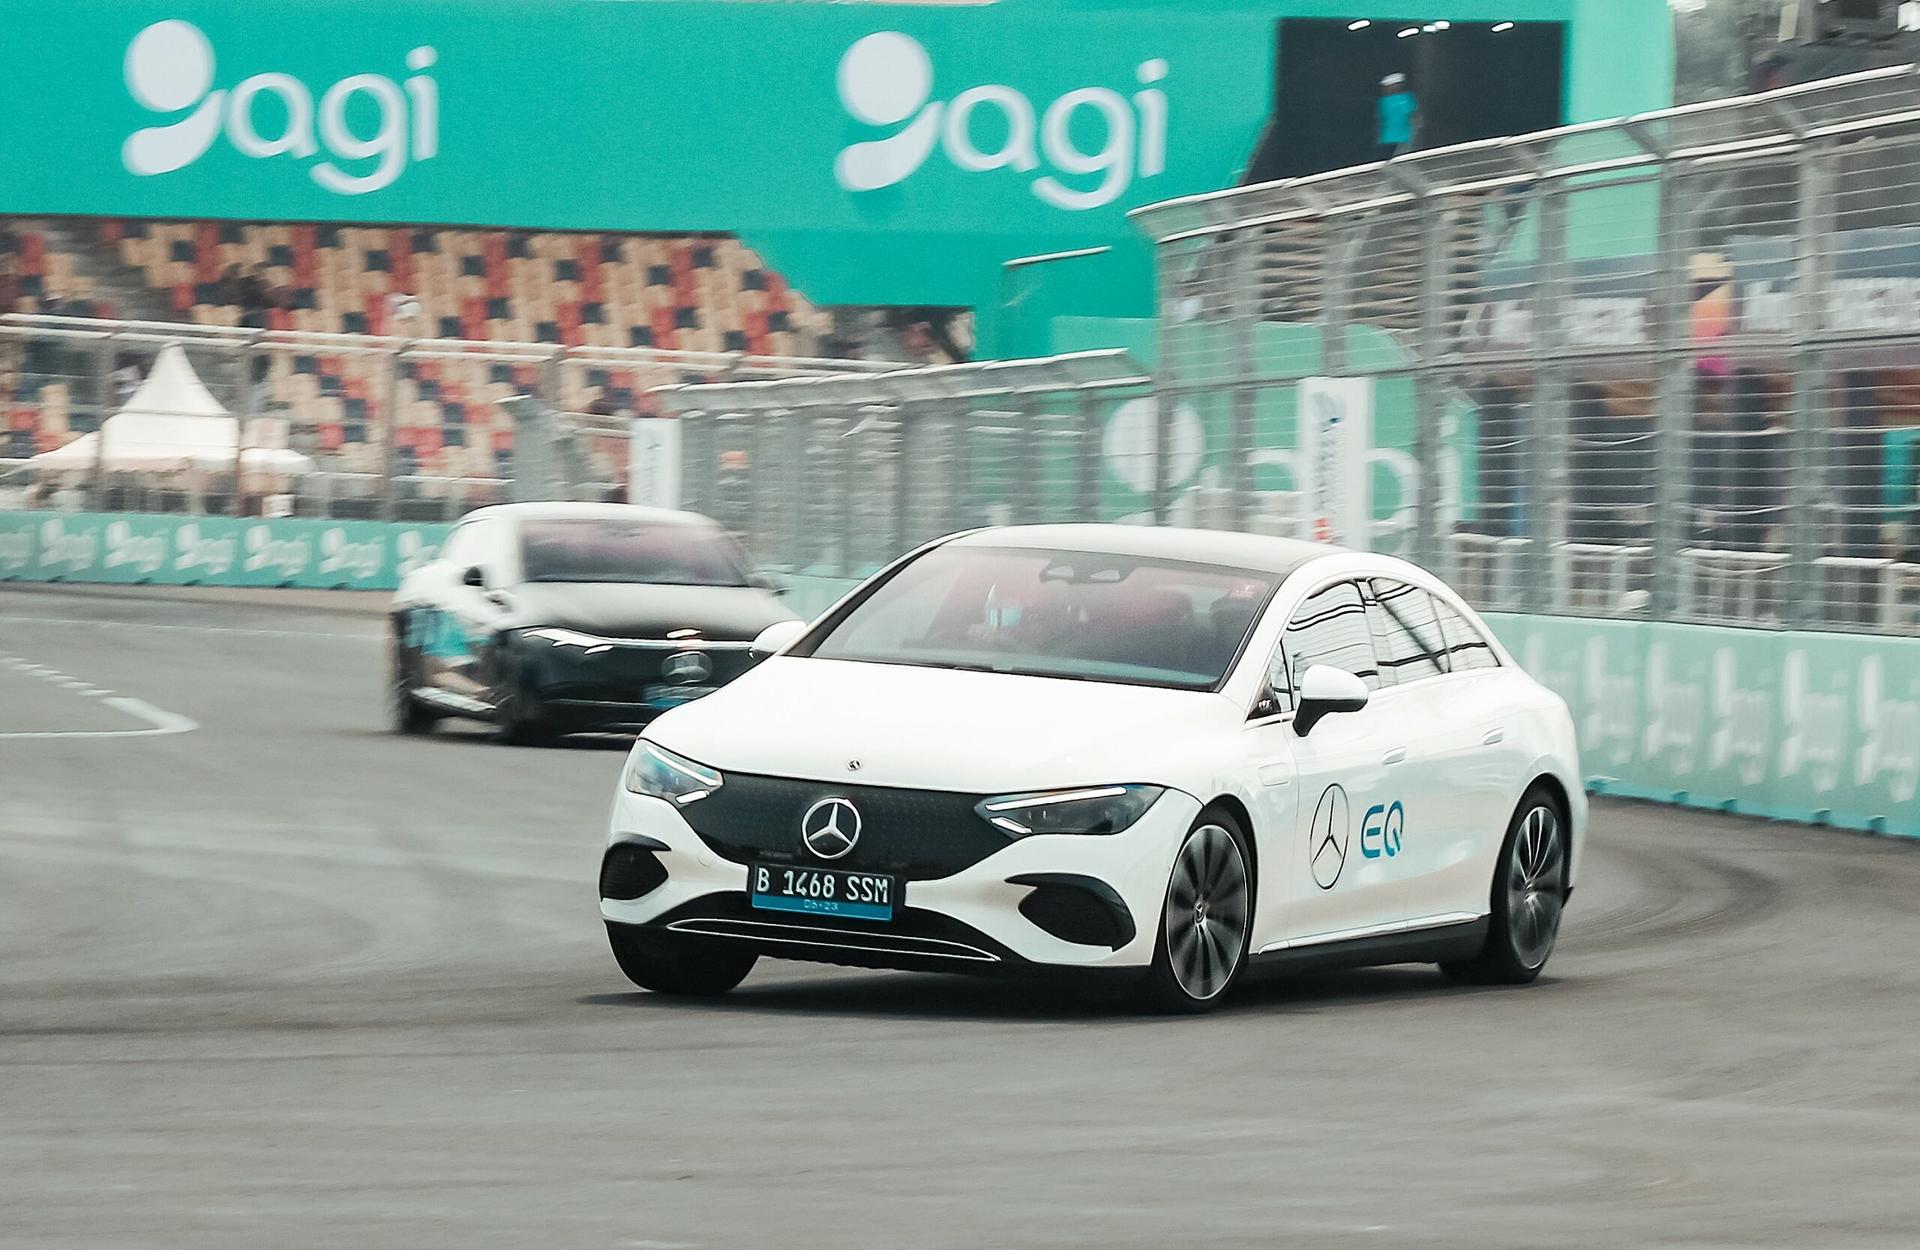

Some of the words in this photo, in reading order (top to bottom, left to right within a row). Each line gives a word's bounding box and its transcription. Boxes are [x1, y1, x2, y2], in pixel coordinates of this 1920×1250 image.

[1361, 800, 1404, 859] EQ
[757, 867, 770, 892] B
[782, 870, 836, 899] 1468
[845, 875, 889, 904] SSM
